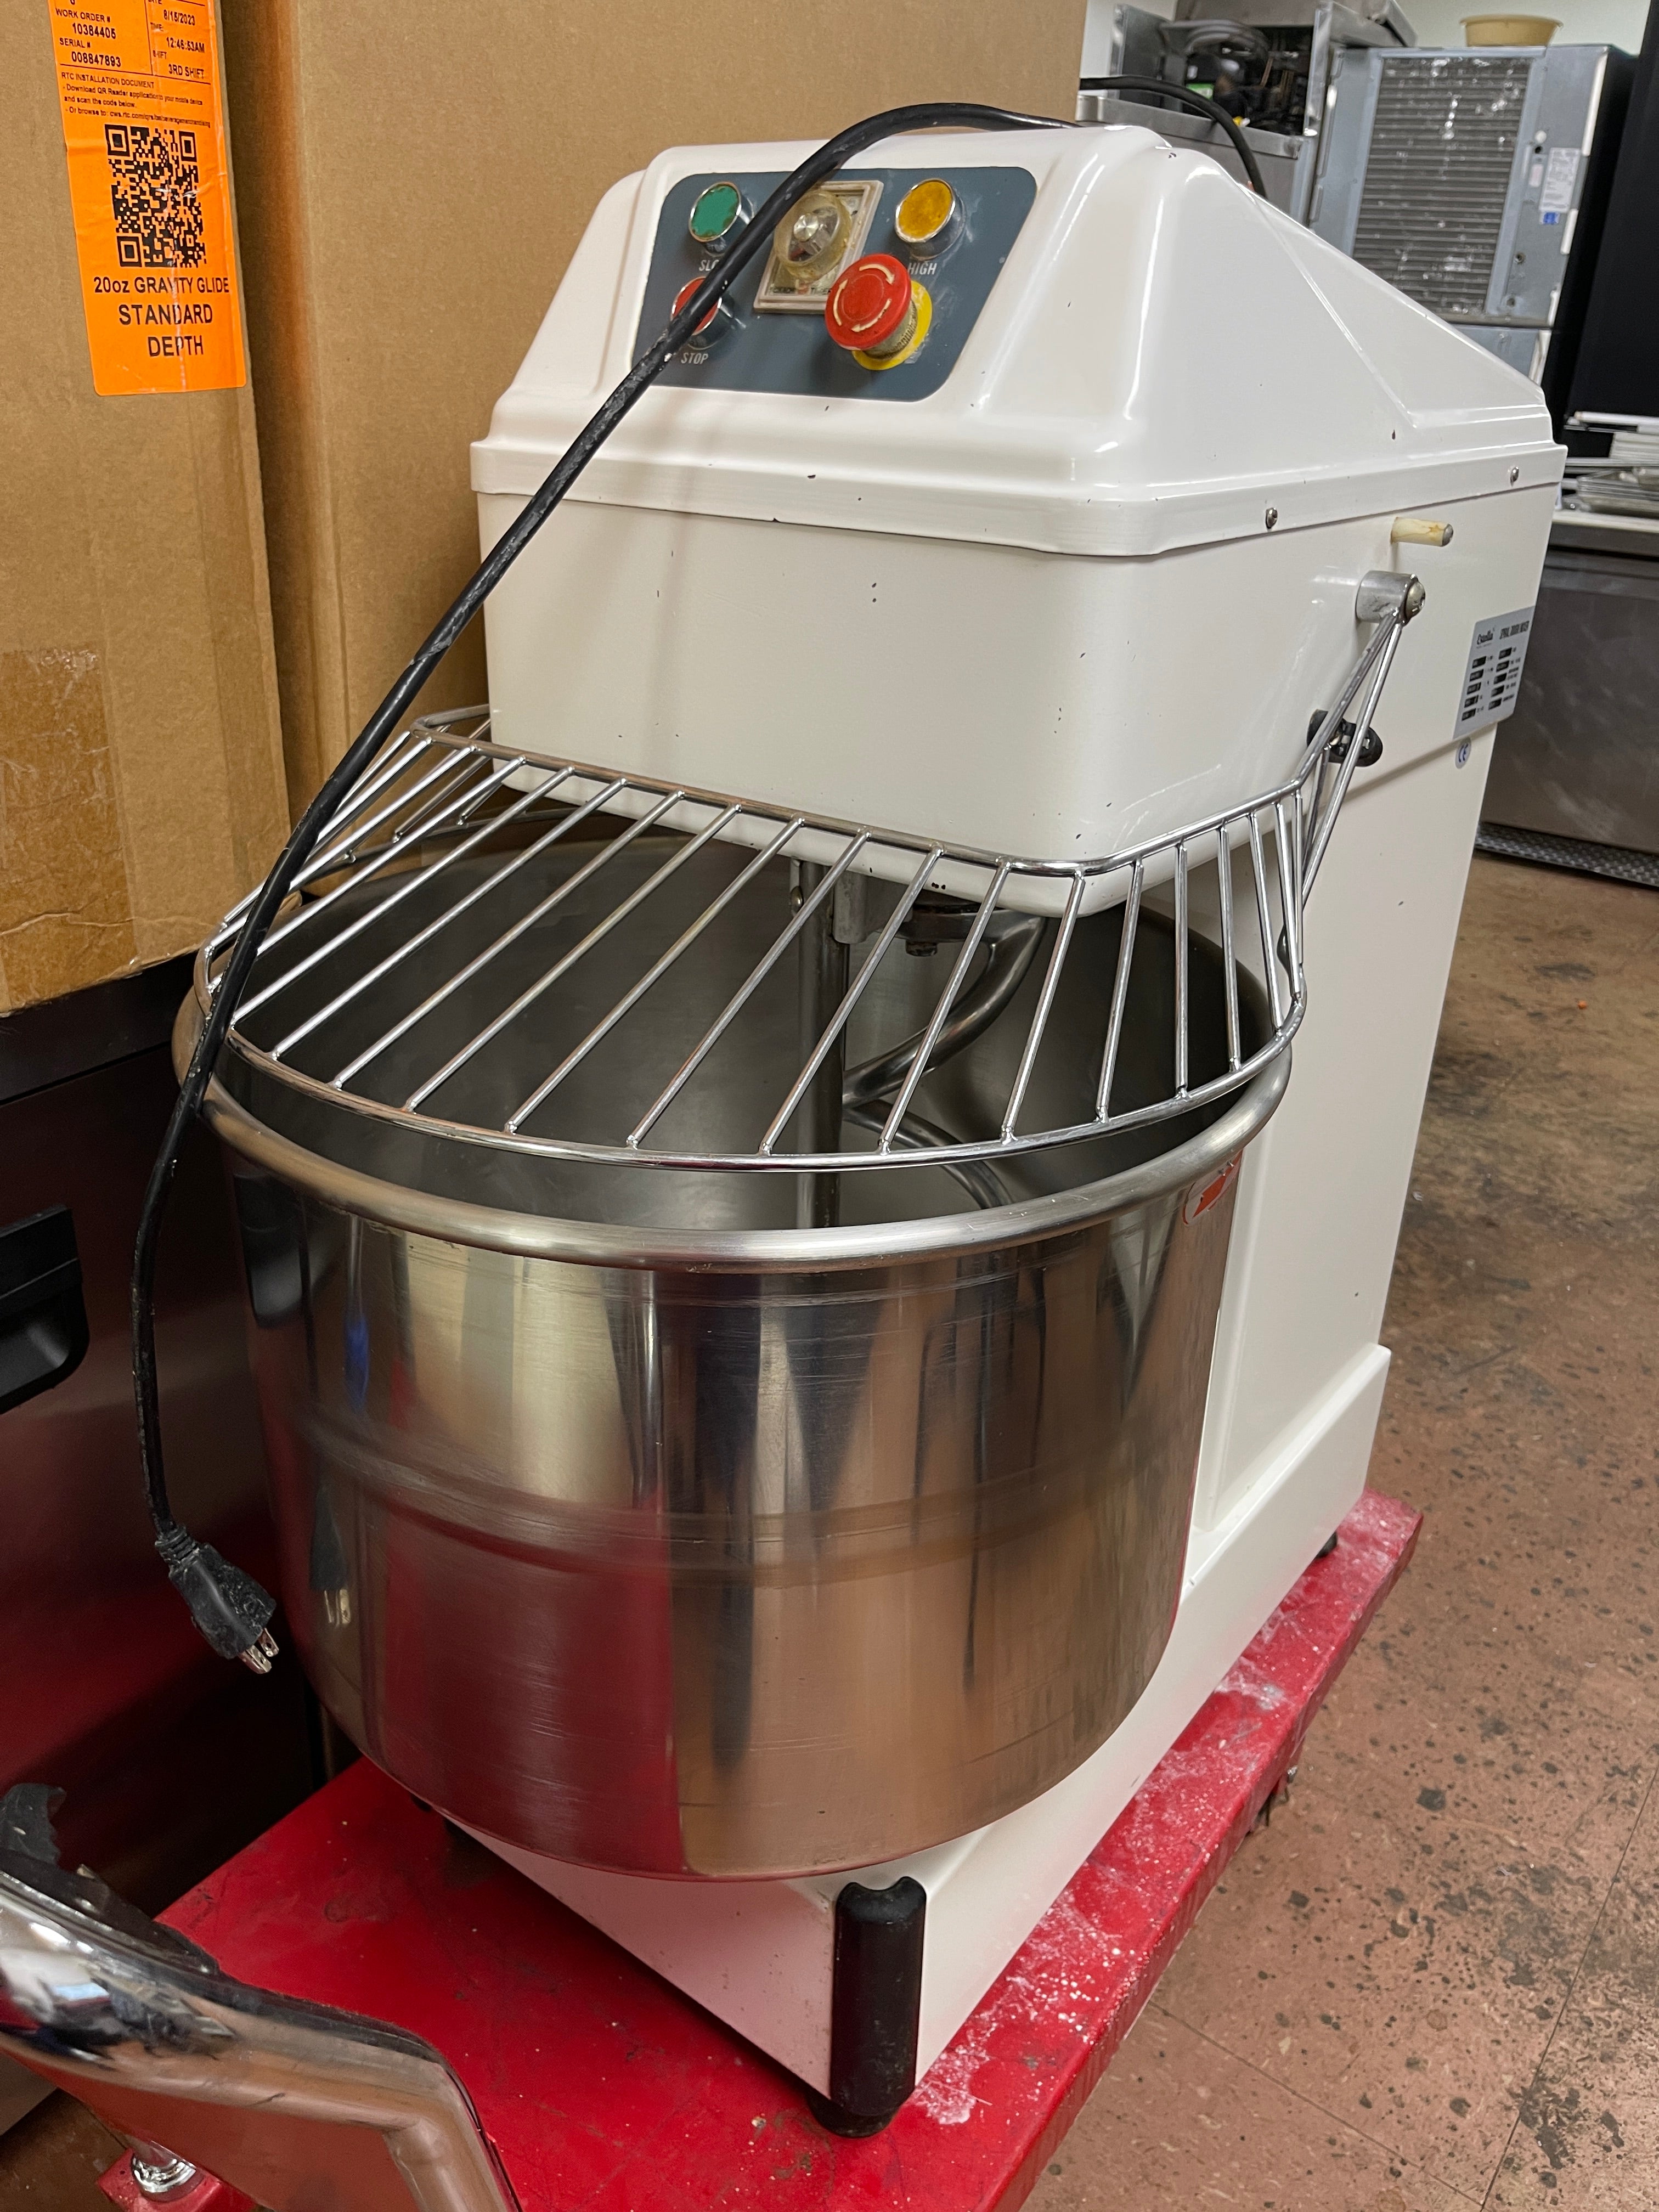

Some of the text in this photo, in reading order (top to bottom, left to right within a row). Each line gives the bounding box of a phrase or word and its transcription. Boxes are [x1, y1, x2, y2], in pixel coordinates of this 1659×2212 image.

[55, 8, 78, 18] WORK
[80, 12, 105, 22] ORDER
[59, 38, 85, 48] SERIAL
[71, 51, 121, 67] 008847893
[168, 64, 204, 79] 3RD SHIFT
[66, 83, 96, 93] Download
[76, 74, 120, 84] INSTALLATION
[121, 78, 154, 88] DOCUMENT
[907, 263, 937, 275] HIGH
[94, 276, 229, 294] 20oz GRAVITY GLIDE
[119, 304, 213, 325] STANDARD
[148, 335, 204, 357] DEPTH
[681, 352, 709, 365] STOP
